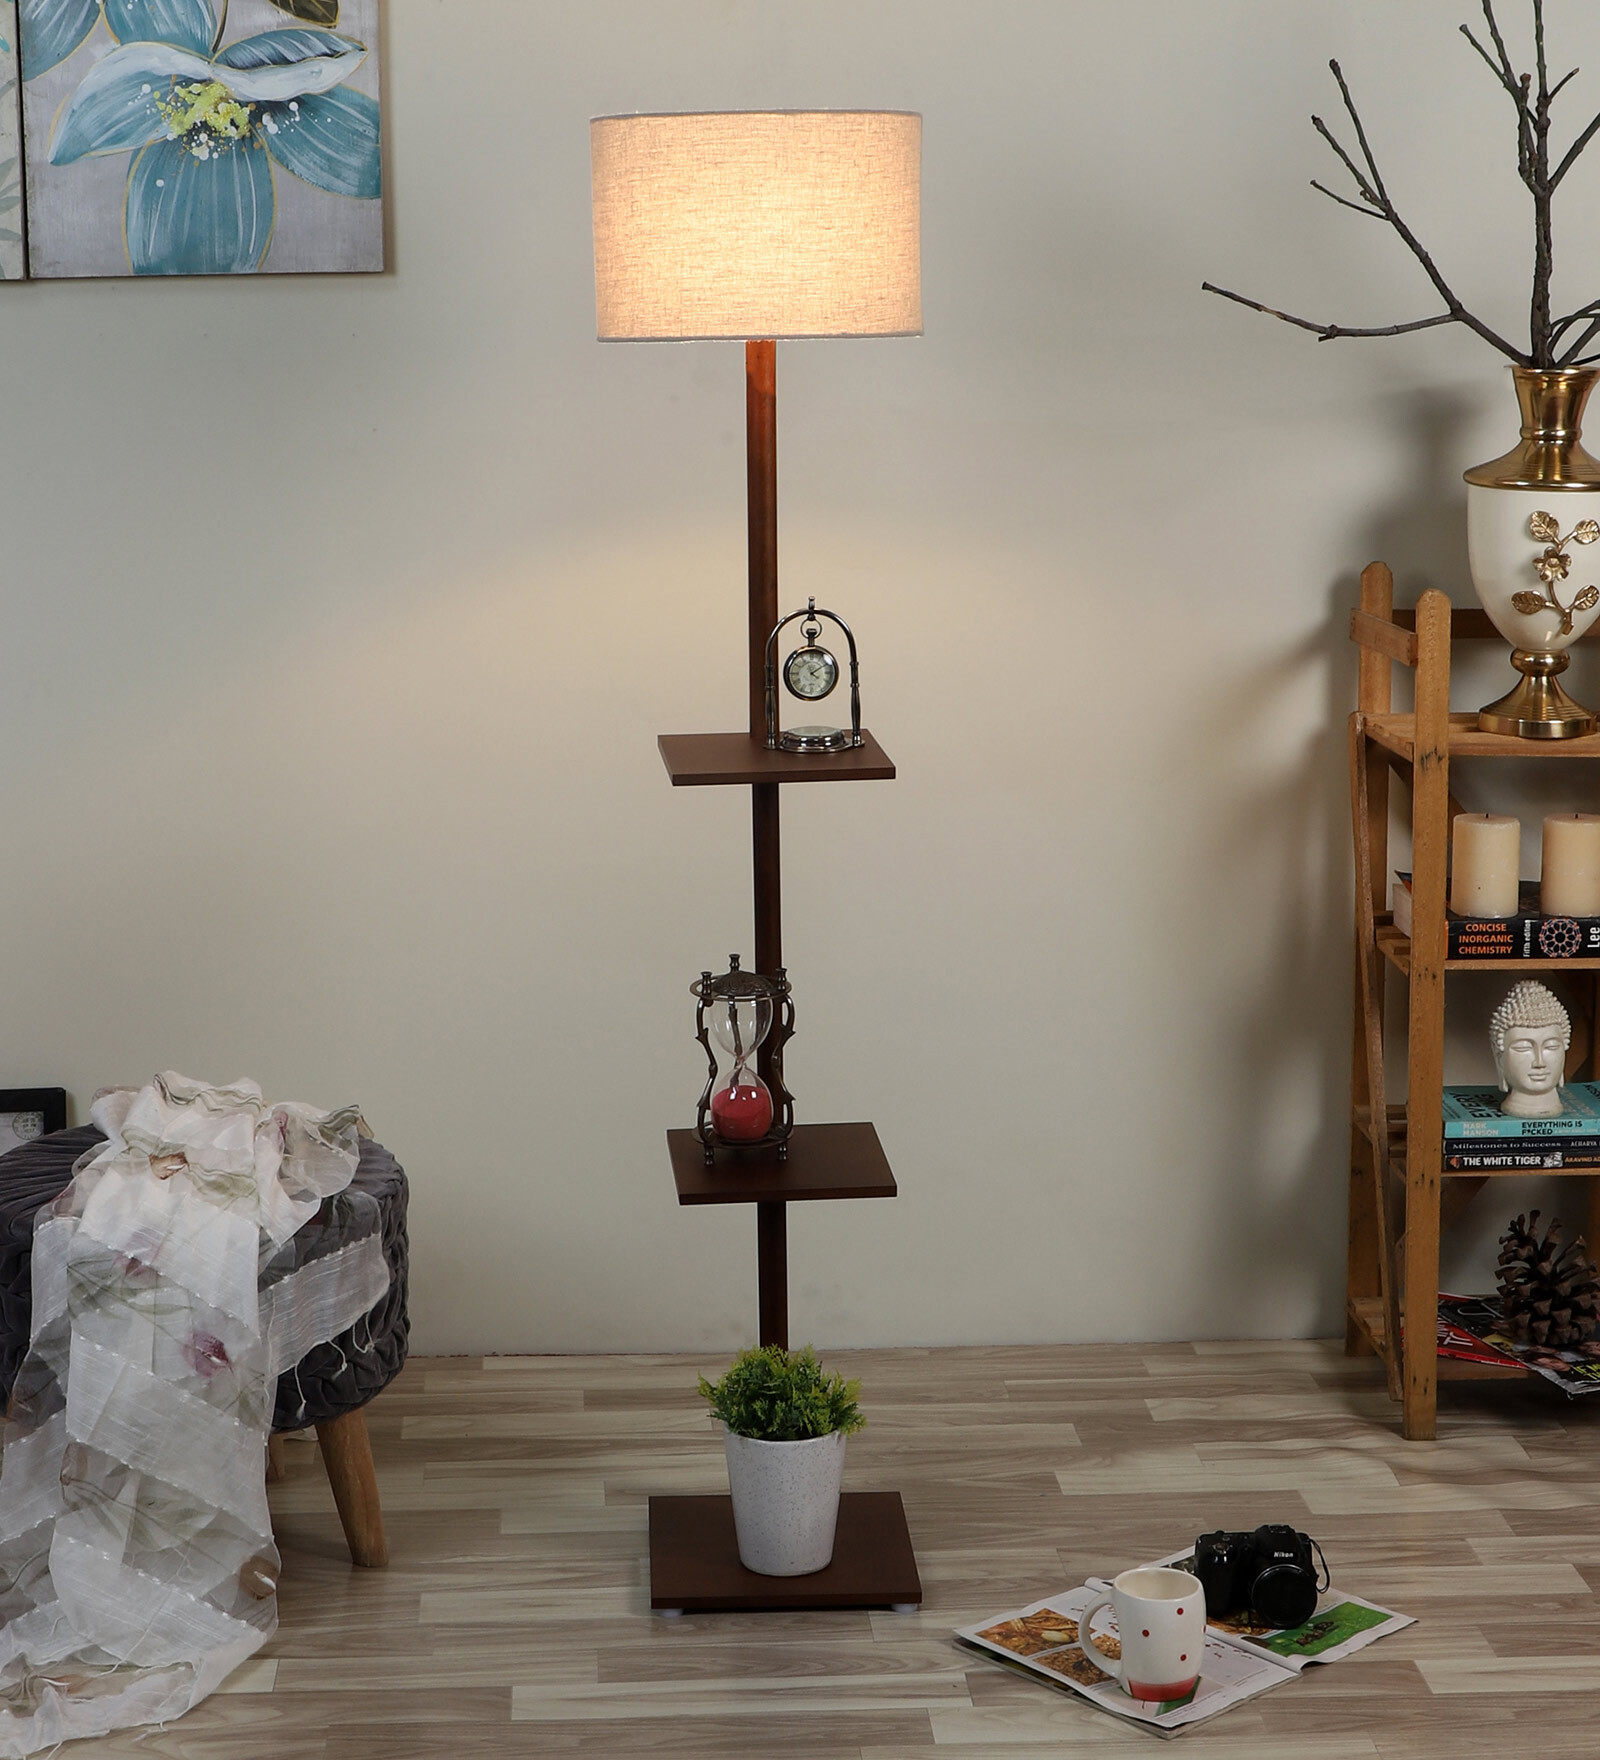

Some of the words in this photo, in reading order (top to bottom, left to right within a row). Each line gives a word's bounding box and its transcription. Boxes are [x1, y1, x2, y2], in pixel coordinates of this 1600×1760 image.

[1465, 923, 1507, 932] CONCISE
[1523, 919, 1531, 941] edition
[1458, 934, 1514, 943] INORGANIC
[1587, 926, 1600, 948] Lee
[1458, 946, 1513, 955] CHEMISTRY
[1521, 1121, 1573, 1129] EVERYTHING
[1575, 1120, 1583, 1128] IS
[1452, 1142, 1508, 1150] Milestones
[1463, 1157, 1481, 1166] THE
[1483, 1156, 1513, 1165] WHITE
[1514, 1155, 1541, 1165] TIGER
